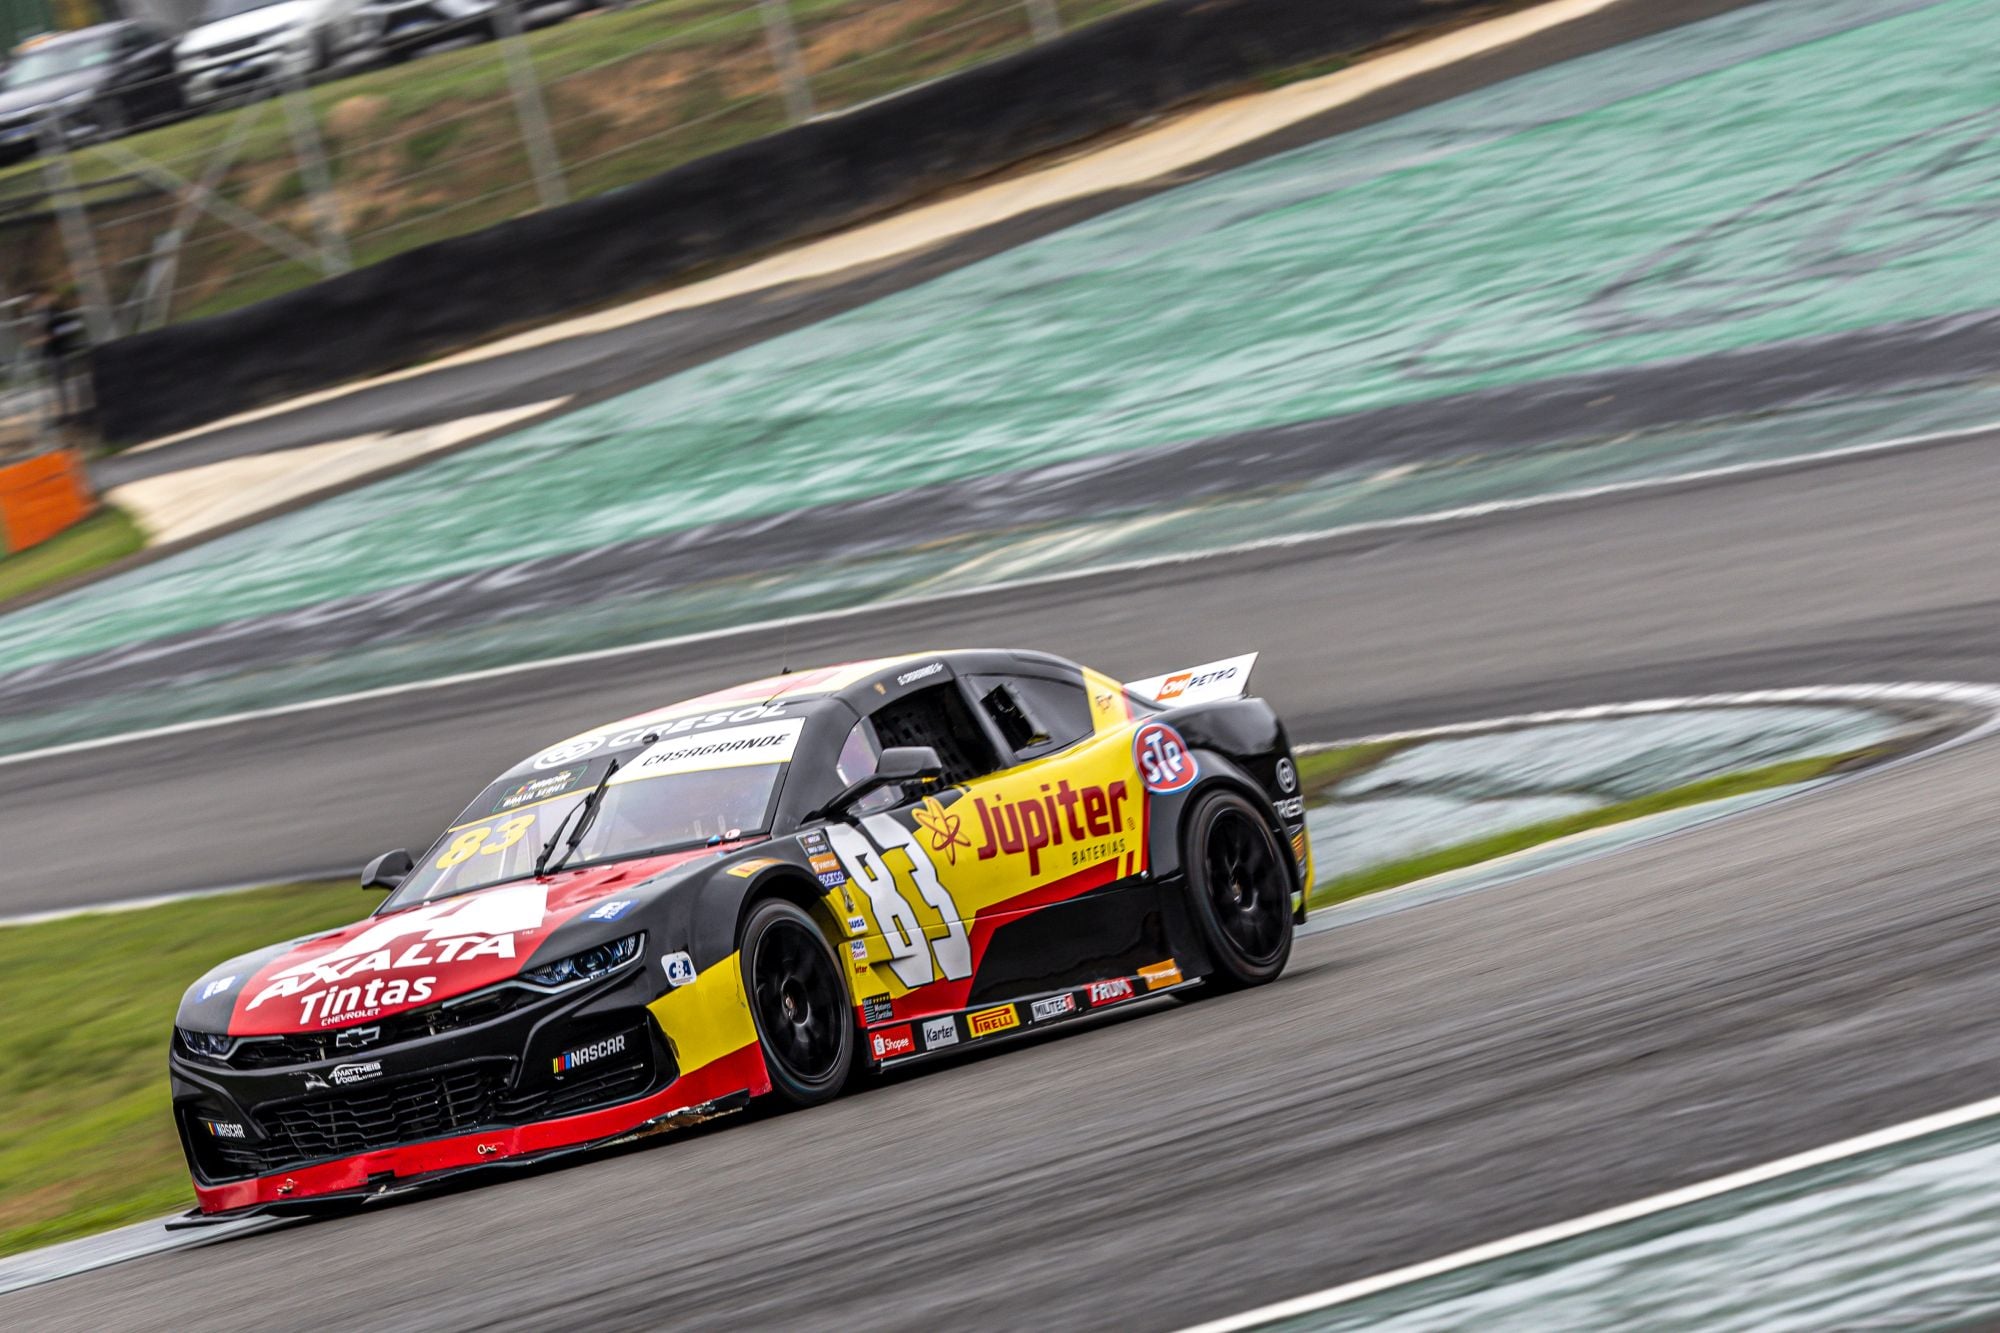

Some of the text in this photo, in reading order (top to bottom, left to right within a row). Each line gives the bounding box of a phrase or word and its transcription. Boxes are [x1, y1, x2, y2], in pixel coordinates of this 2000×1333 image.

[1187, 667, 1238, 689] PETRO
[641, 733, 791, 767] CASAGRANDE
[1141, 730, 1183, 783] STP
[436, 814, 536, 870] 83
[1071, 838, 1126, 866] BATERIAS
[825, 813, 973, 989] 83
[245, 932, 517, 1011] AXALTA
[668, 959, 692, 979] CBA
[299, 976, 437, 1025] Tintas
[321, 1007, 381, 1027] CHEVROLET
[972, 1007, 1014, 1035] PIRELLI
[885, 1038, 910, 1052] Shopee
[926, 1025, 954, 1043] Karter
[570, 1034, 626, 1068] NASCAR
[336, 1062, 381, 1078] MATTHEIS
[217, 1123, 246, 1139] NASCAR
